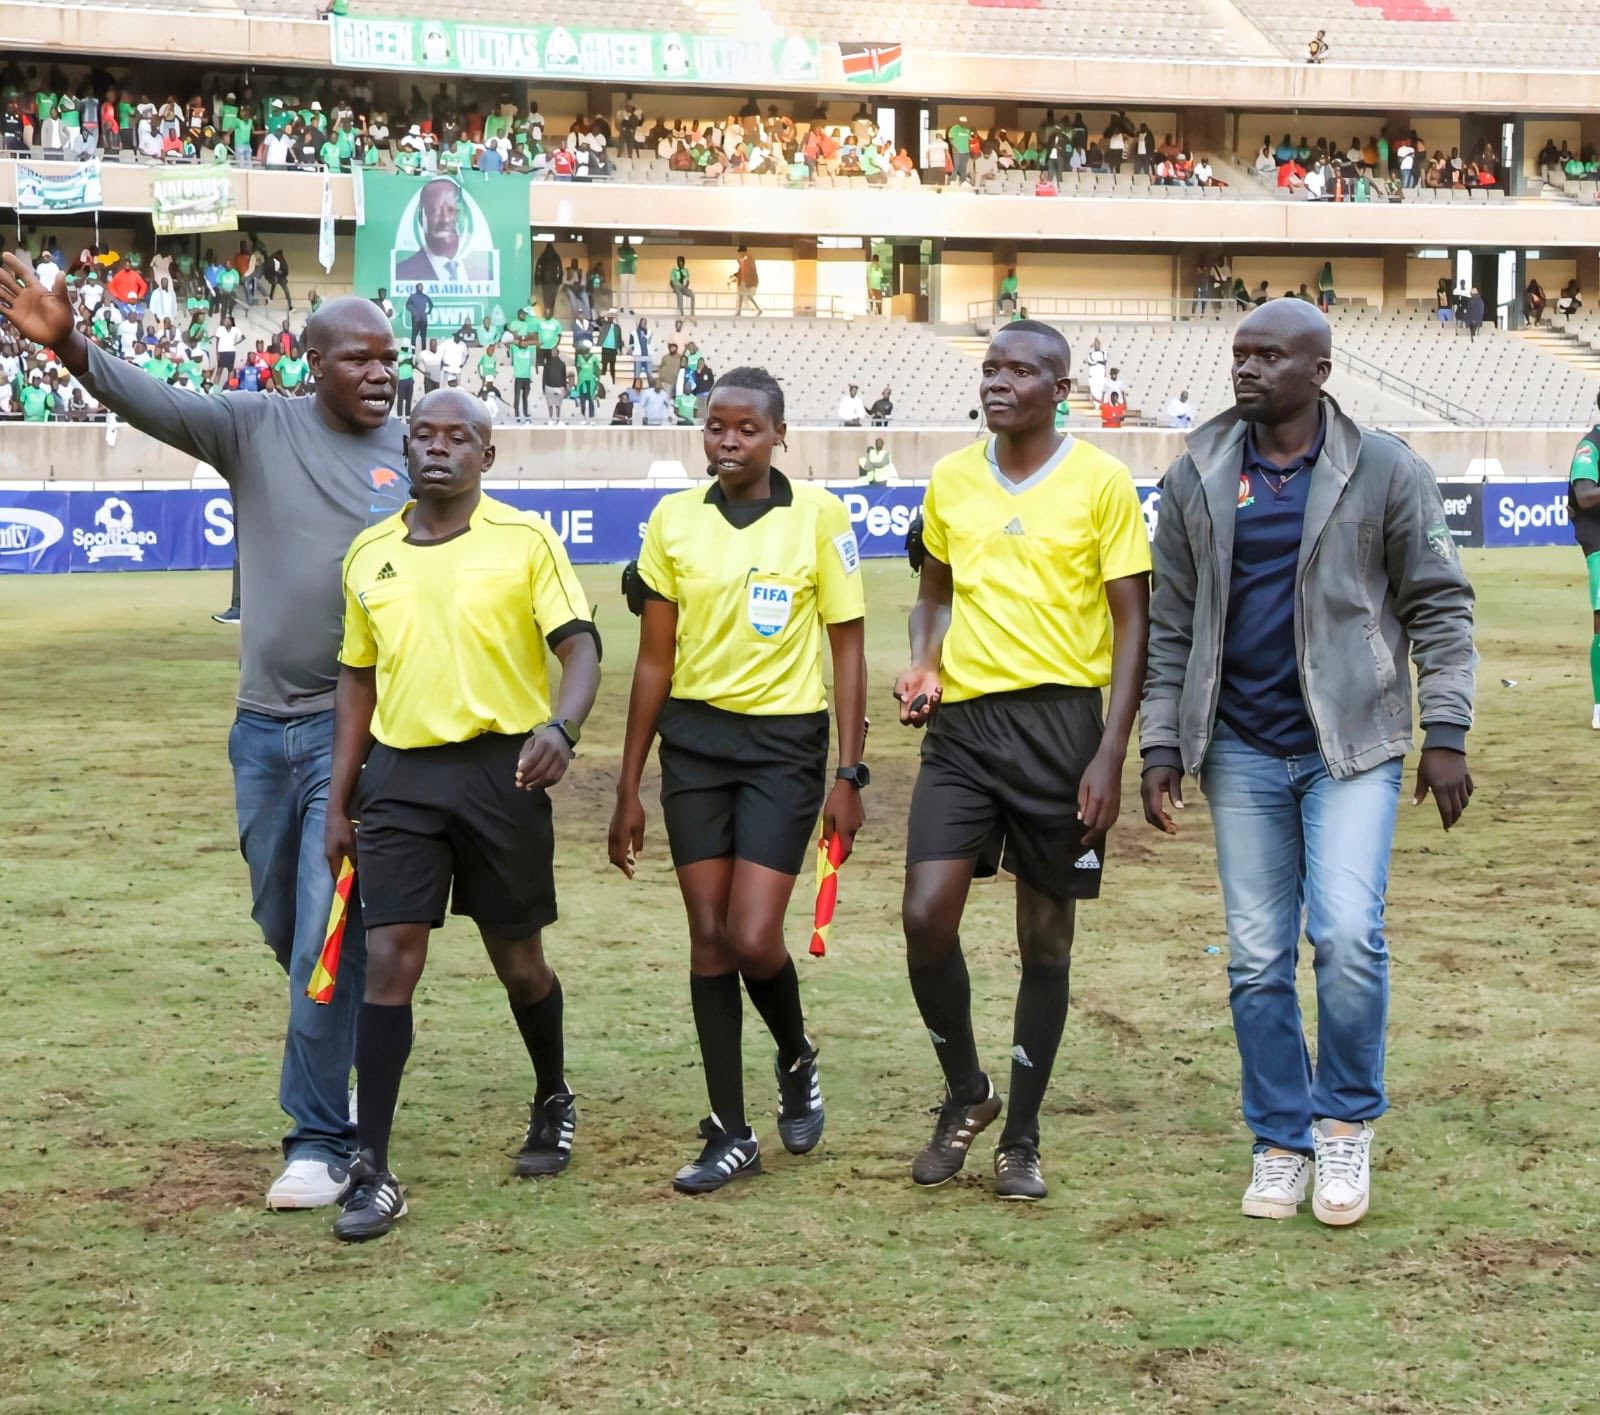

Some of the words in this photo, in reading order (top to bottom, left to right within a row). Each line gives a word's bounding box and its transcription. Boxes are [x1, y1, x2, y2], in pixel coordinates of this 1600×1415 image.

[340, 21, 412, 61] GREEN
[456, 28, 542, 69] ULTRAS
[73, 527, 157, 550] SportPesa
[753, 586, 788, 603] FIFA
